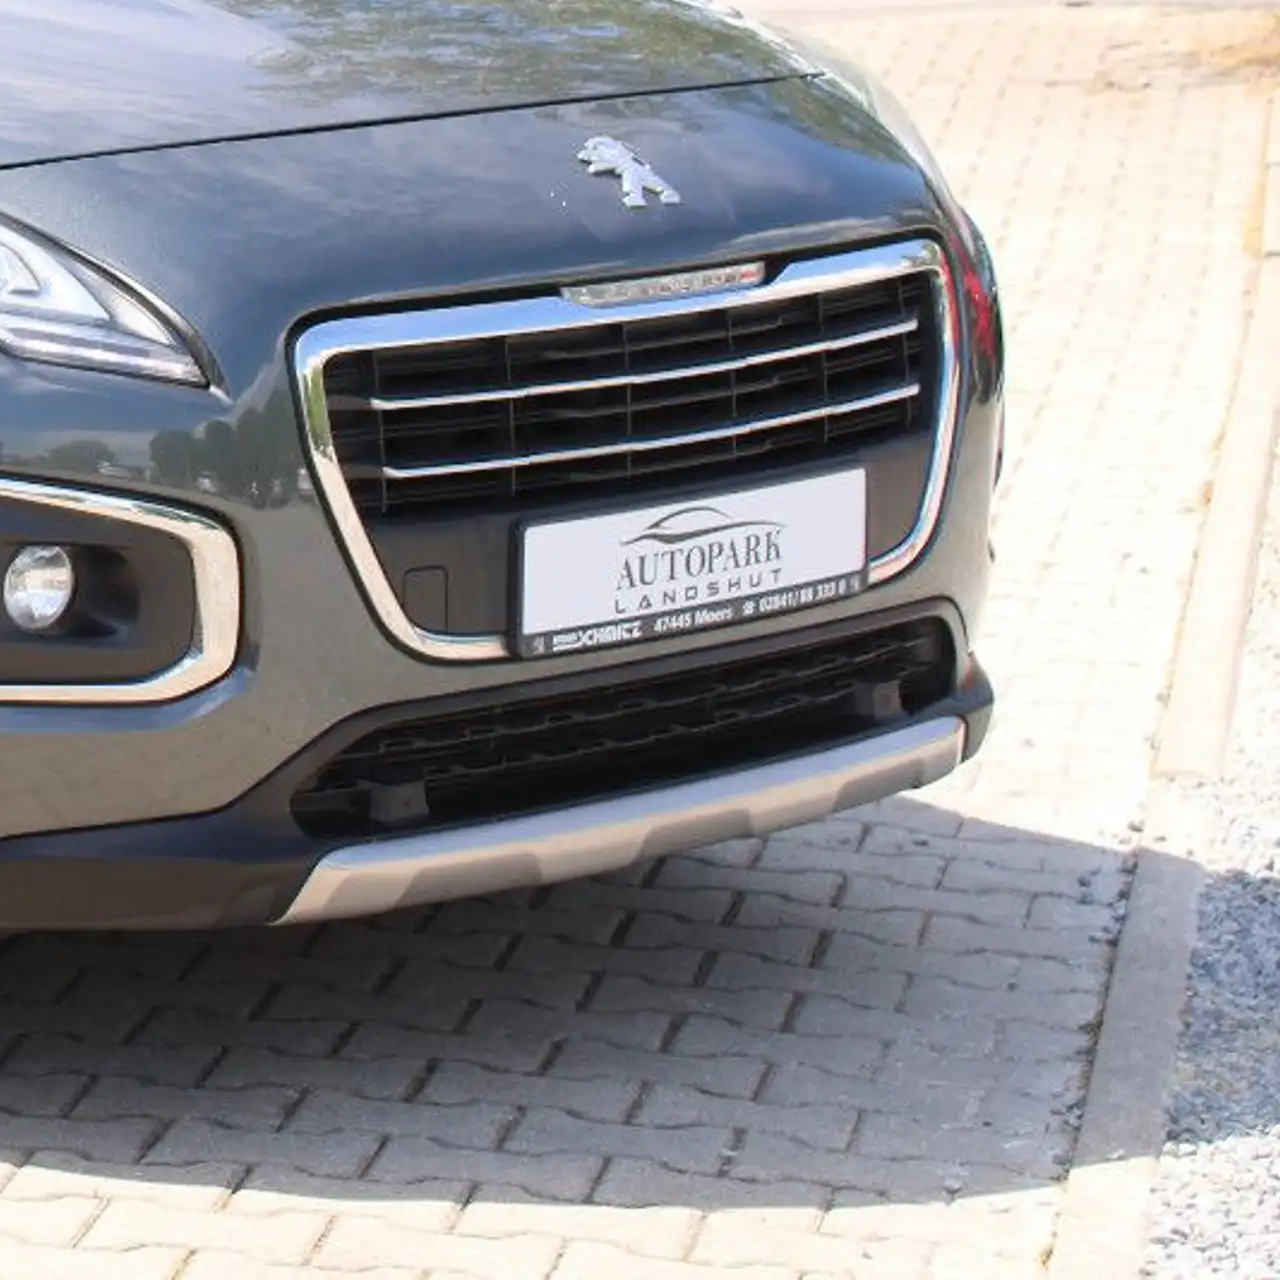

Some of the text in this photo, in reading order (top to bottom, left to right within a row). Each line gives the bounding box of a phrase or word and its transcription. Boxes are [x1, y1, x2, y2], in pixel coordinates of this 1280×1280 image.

[615, 529, 782, 591] AUTOPARK
[614, 567, 783, 615] LANDSHUT
[694, 606, 734, 626] Moers
